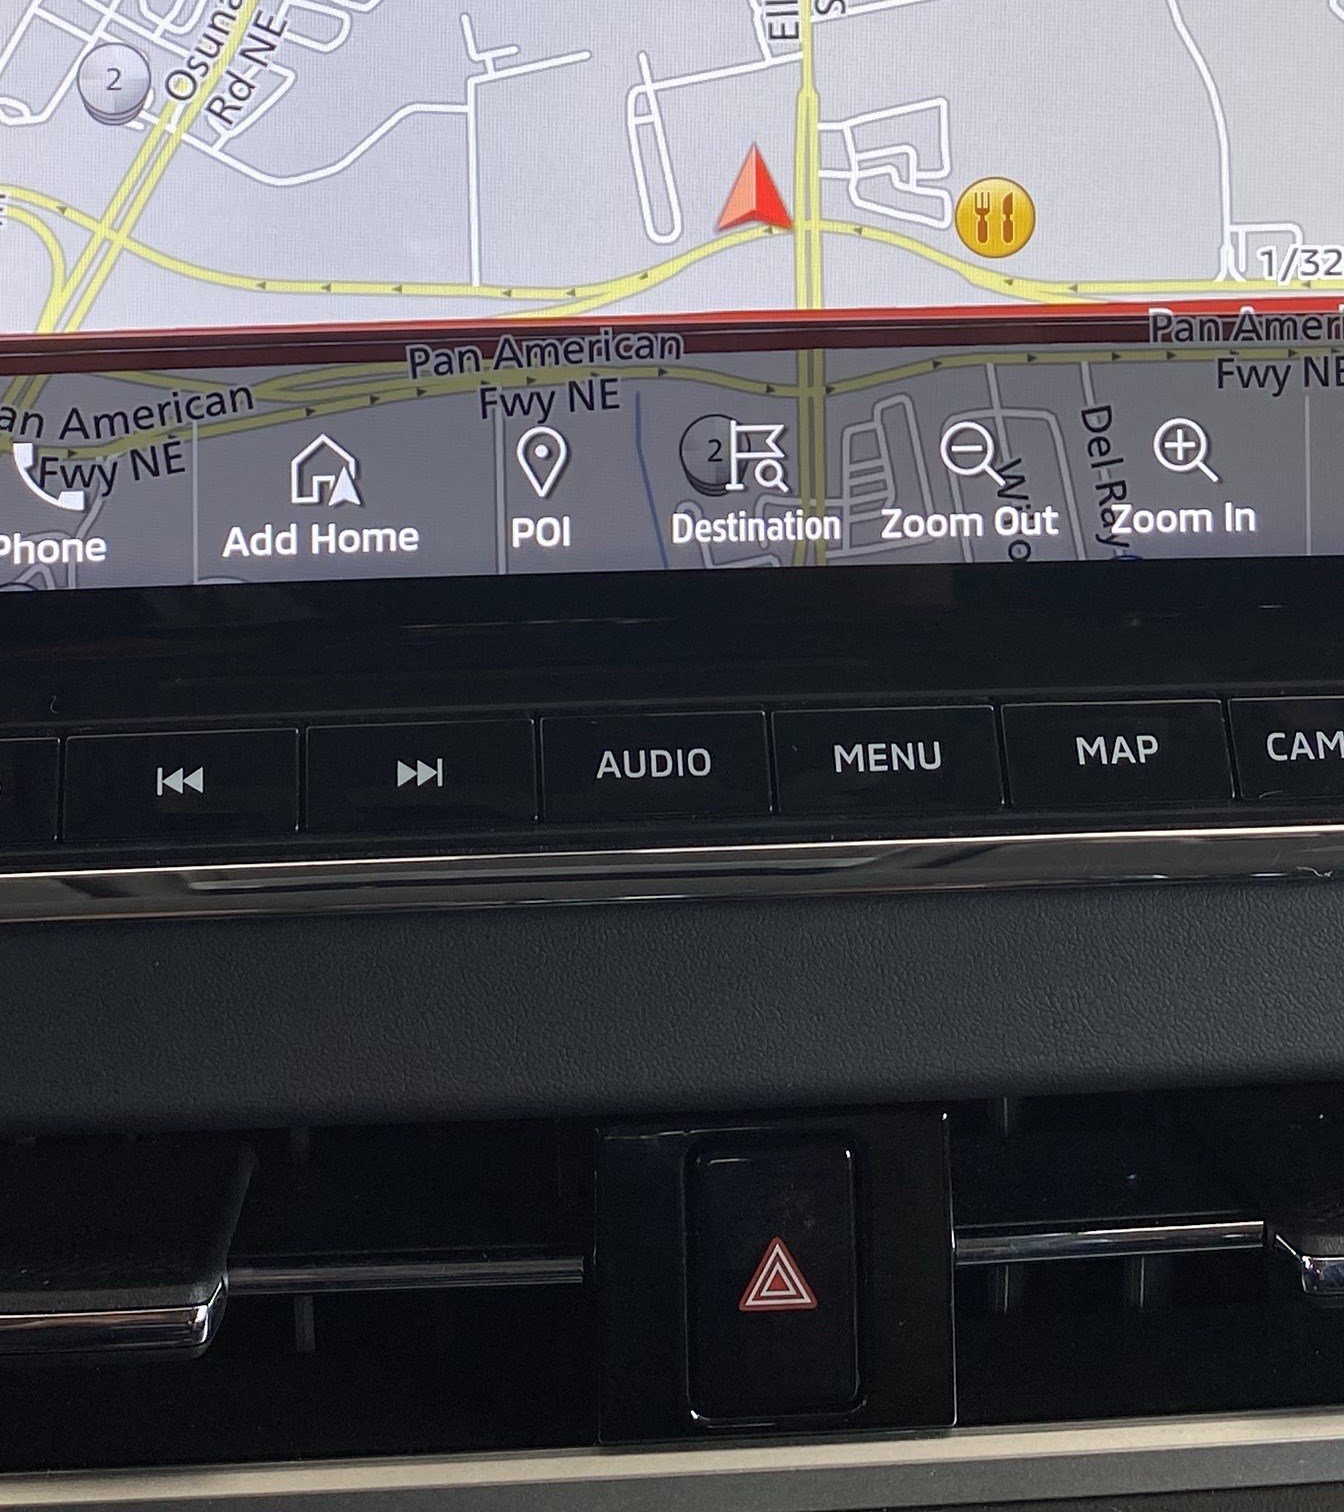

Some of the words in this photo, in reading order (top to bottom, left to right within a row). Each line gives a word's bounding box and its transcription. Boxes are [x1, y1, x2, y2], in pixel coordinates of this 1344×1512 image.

[106, 67, 123, 91] 2
[205, 68, 256, 125] Rd
[238, 9, 288, 68] NE
[1151, 311, 1221, 344] Pan
[408, 346, 481, 380] Pan
[493, 328, 682, 370] American
[1216, 357, 1292, 398] Fwy
[58, 386, 254, 440] American
[479, 386, 556, 425] Fwy
[568, 377, 621, 413] NE
[707, 438, 724, 463] 2
[1081, 404, 1125, 469] Del
[38, 455, 119, 498] Fwy
[129, 439, 186, 482] NE
[510, 516, 572, 549] POI
[671, 509, 842, 545] Destination
[881, 507, 985, 539] Zoom
[994, 504, 1060, 537] Out
[1110, 502, 1213, 535] Zoom
[1223, 500, 1256, 533] In
[221, 522, 299, 558] Add
[310, 522, 421, 555] Home
[595, 747, 712, 780] AUDIO
[833, 740, 943, 774] MENU
[1075, 734, 1160, 766] MAP
